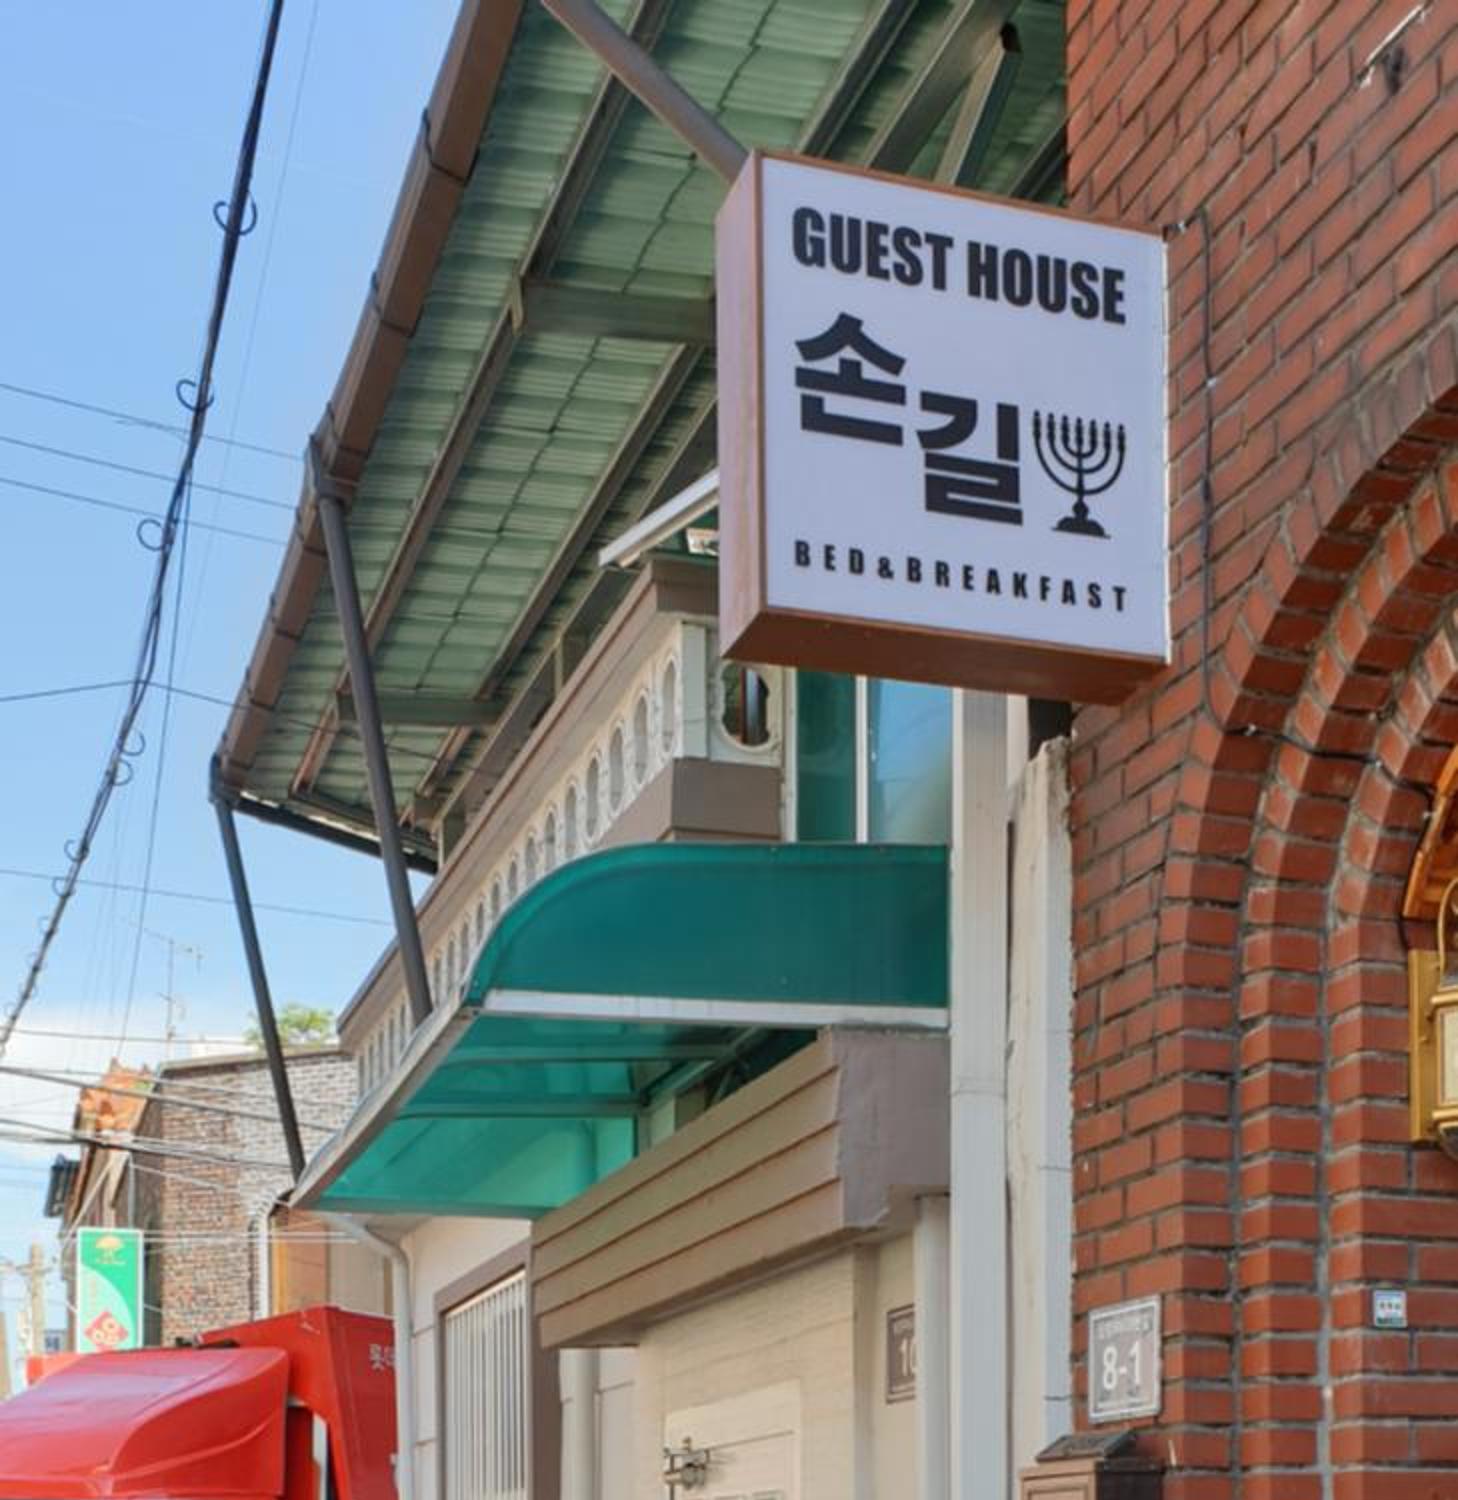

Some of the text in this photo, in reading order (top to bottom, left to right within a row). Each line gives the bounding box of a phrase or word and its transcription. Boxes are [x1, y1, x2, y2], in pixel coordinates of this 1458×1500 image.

[792, 207, 1126, 325] GUEST HOUSE
[794, 312, 1024, 527] 손길
[794, 540, 1126, 612] BED&BREAKFAST
[1102, 1340, 1141, 1390] 8-1
